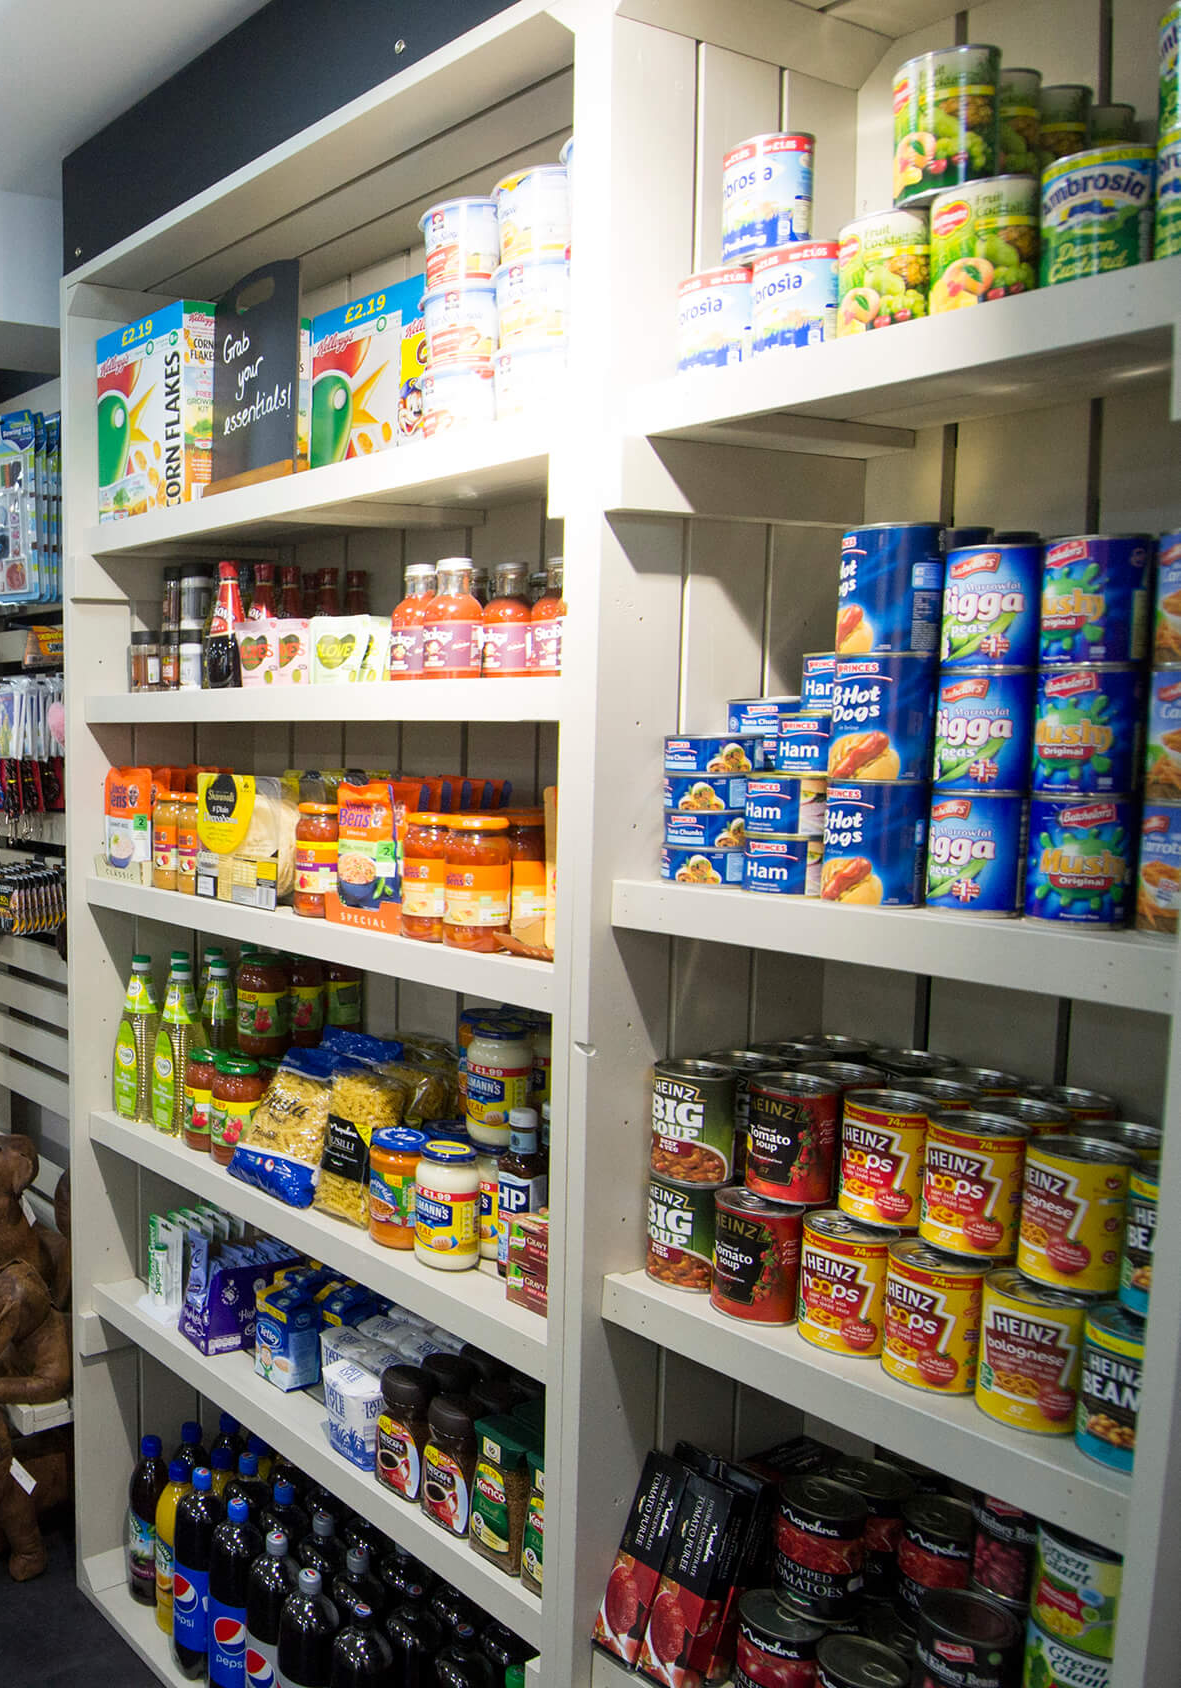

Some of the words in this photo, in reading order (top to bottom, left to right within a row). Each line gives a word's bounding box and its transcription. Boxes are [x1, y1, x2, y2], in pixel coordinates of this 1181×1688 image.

[344, 294, 387, 325] £2.19
[121, 319, 153, 347] £2.19
[223, 331, 251, 363] Grab
[235, 355, 264, 401] your
[165, 350, 181, 441] FLAKES
[223, 382, 293, 437] essentials!
[837, 663, 879, 673] PRINCES
[783, 721, 818, 731] PRINCES
[832, 704, 881, 723] Dogs
[778, 741, 820, 759] Ham
[747, 782, 781, 792] PRINCES
[744, 801, 781, 820] Ham
[750, 842, 788, 853] PRINCES
[746, 861, 789, 881] Ham
[1059, 877, 1105, 888] Original
[339, 911, 387, 929] SPECIAL
[475, 1065, 504, 1077] £1.99
[655, 1080, 696, 1101] HEINZ
[652, 1093, 704, 1129] BIG
[652, 1121, 699, 1142] SOUP
[750, 1123, 791, 1146] Tomato
[845, 1125, 890, 1152] HEINZ
[755, 1139, 778, 1154] soup
[929, 1149, 982, 1178] HEINZ
[424, 1187, 452, 1201] £1.99
[926, 1168, 986, 1200] hoops
[719, 1255, 740, 1271] soup
[806, 1253, 857, 1282] HEINZ
[803, 1268, 860, 1303] hoops
[888, 1280, 934, 1313] HEINZ
[259, 1323, 280, 1346] Tetley
[994, 1314, 1057, 1346] HEINZ
[987, 1334, 1067, 1368] bolognese
[476, 1477, 507, 1505] Kenco
[644, 1471, 663, 1512] TOMATO
[635, 1510, 652, 1547] PUREE
[688, 1495, 707, 1537] TOMATO
[780, 1504, 841, 1537] Napolina
[678, 1535, 695, 1573] PUREE
[778, 1552, 833, 1585] CHOPPED
[1044, 1553, 1093, 1588] Giant
[739, 1623, 800, 1658] Napolina
[1047, 1644, 1108, 1679] Green
[1050, 1660, 1111, 1688] Giant
